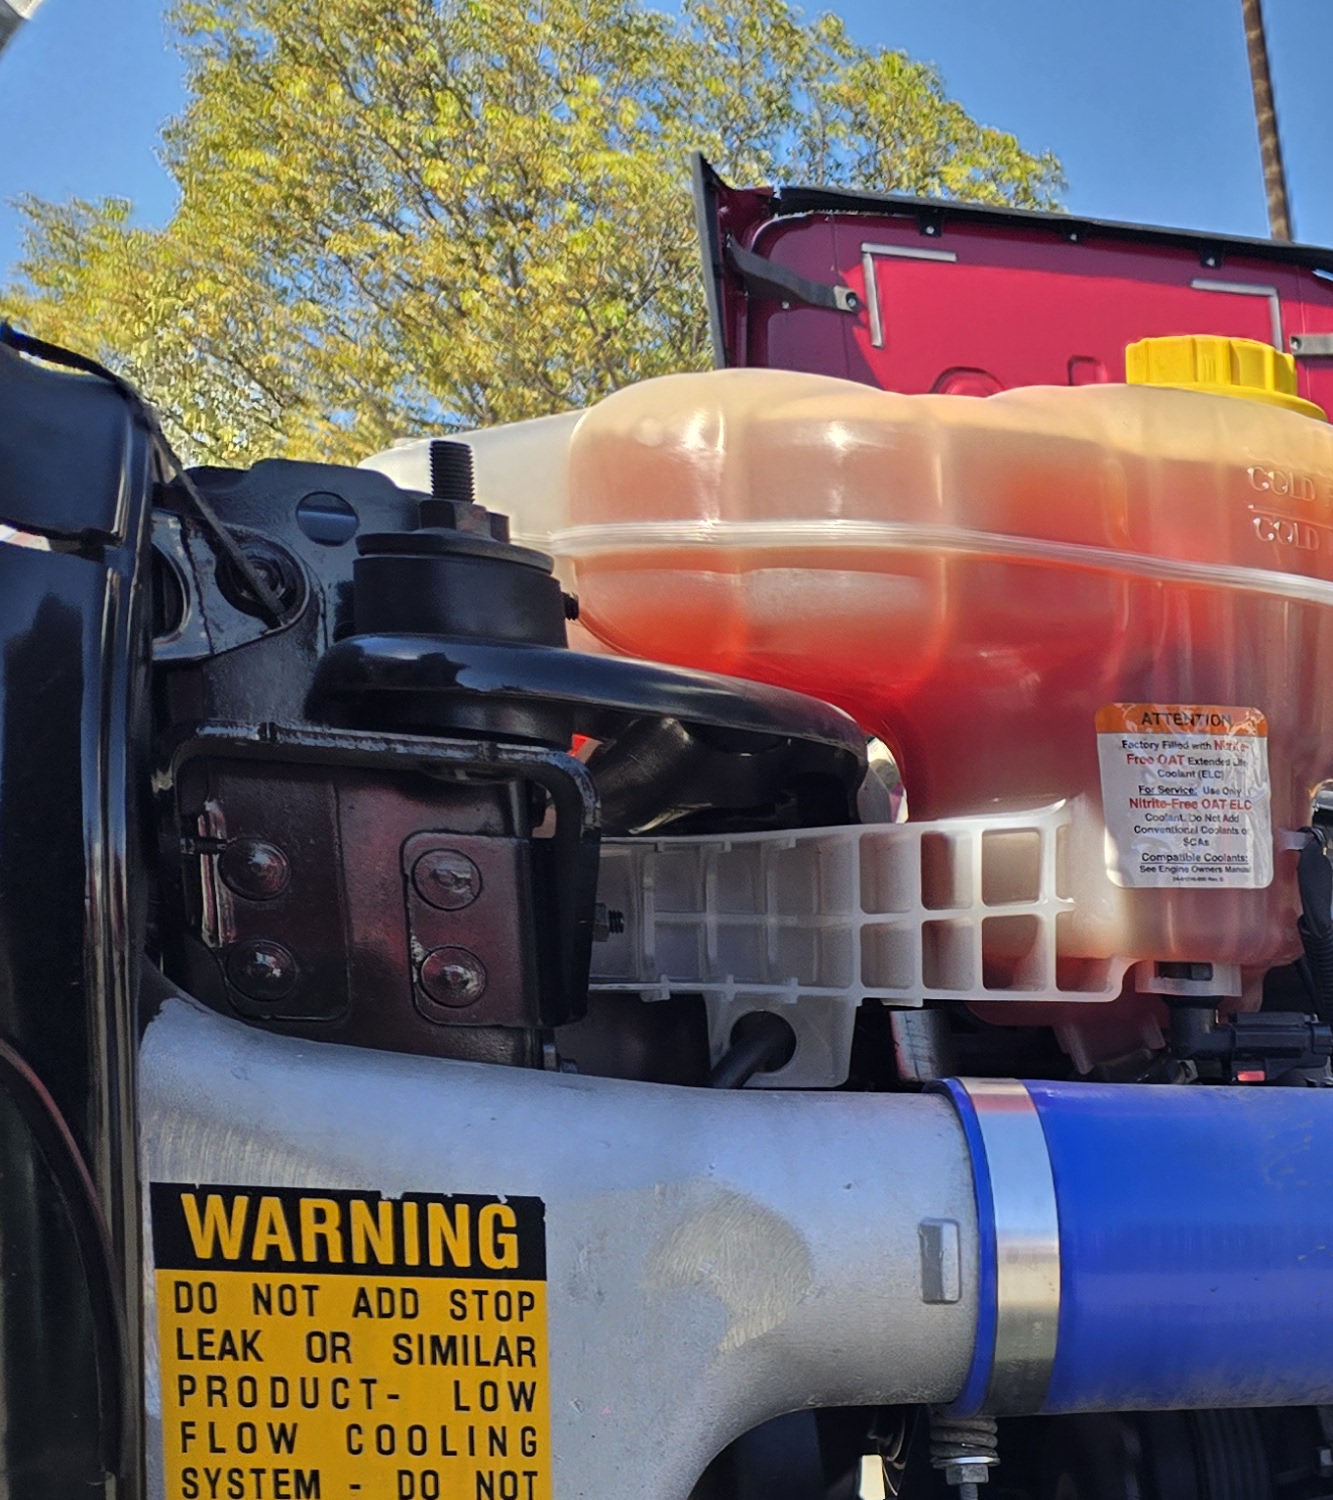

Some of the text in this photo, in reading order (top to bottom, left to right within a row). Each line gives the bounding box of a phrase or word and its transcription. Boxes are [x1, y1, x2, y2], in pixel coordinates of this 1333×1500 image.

[1247, 465, 1316, 502] COLD
[1253, 516, 1321, 551] COLD
[1141, 712, 1232, 727] ATTENTION
[1122, 740, 1159, 752] Factory
[1127, 754, 1155, 765] Free
[1157, 754, 1185, 766] OAT
[1188, 757, 1231, 767] Extended
[1157, 769, 1224, 780] Coolant (ELC)
[1139, 785, 1241, 796] For Service: Use Only
[1129, 798, 1252, 810] Nitrite-Free OAT ELC
[1189, 814, 1202, 822] Do
[1205, 814, 1220, 822] Not
[1223, 814, 1239, 823] Add
[1134, 825, 1198, 834] Conventional
[1201, 826, 1239, 834] Coolants
[1183, 838, 1209, 847] SCAs
[1142, 853, 1248, 863] Compatible Coolants:
[1159, 866, 1189, 874] Engine
[180, 1192, 520, 1270] WARNING
[174, 1281, 536, 1322] DO NOT ADD STOP
[176, 1328, 537, 1368] LEAK OR SIMILAR
[178, 1375, 537, 1413] PRODUCT- LOW
[181, 1422, 538, 1458] FLOW COOLING
[181, 1468, 322, 1500] SYSTEM
[396, 1469, 440, 1500] DO
